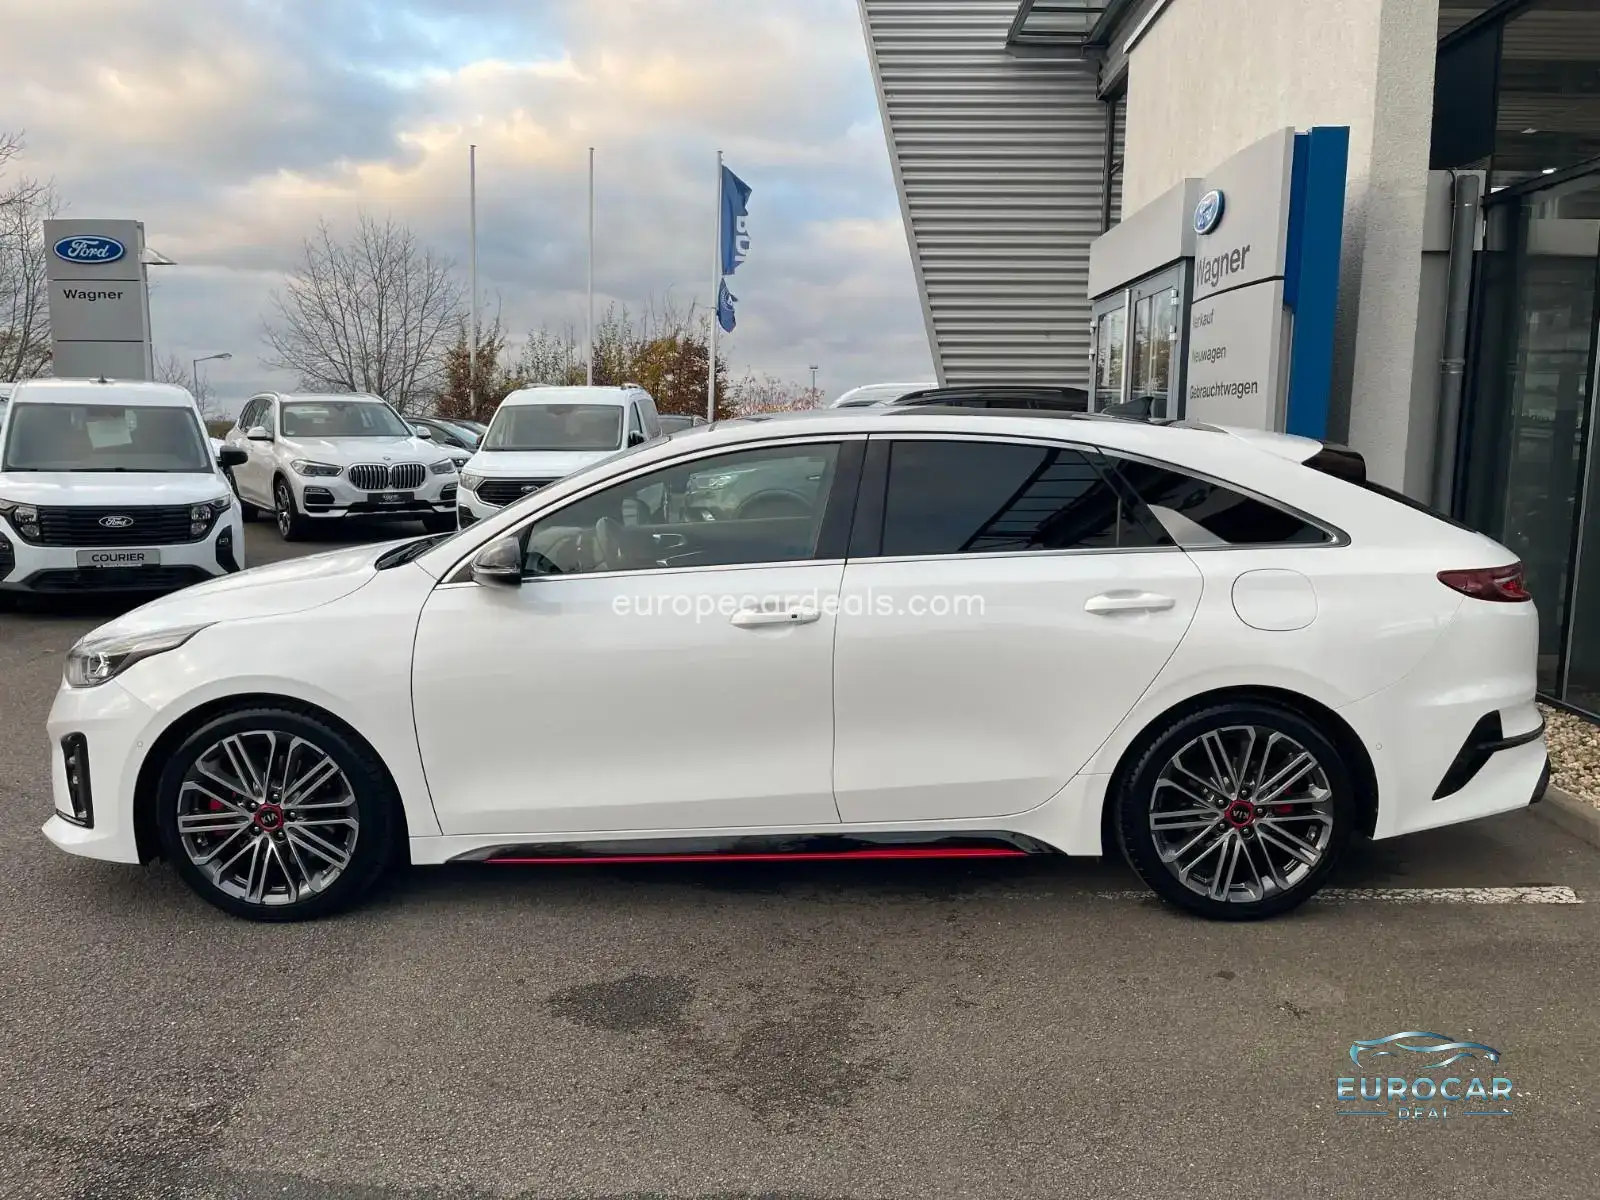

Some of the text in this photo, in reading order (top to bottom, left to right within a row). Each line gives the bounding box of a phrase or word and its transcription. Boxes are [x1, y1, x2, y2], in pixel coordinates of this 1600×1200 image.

[67, 240, 109, 257] Ford
[1196, 244, 1251, 288] Wagner
[63, 289, 123, 301] Wagner
[1190, 381, 1258, 399] Gebrauchtwagen
[91, 553, 145, 562] COURIER
